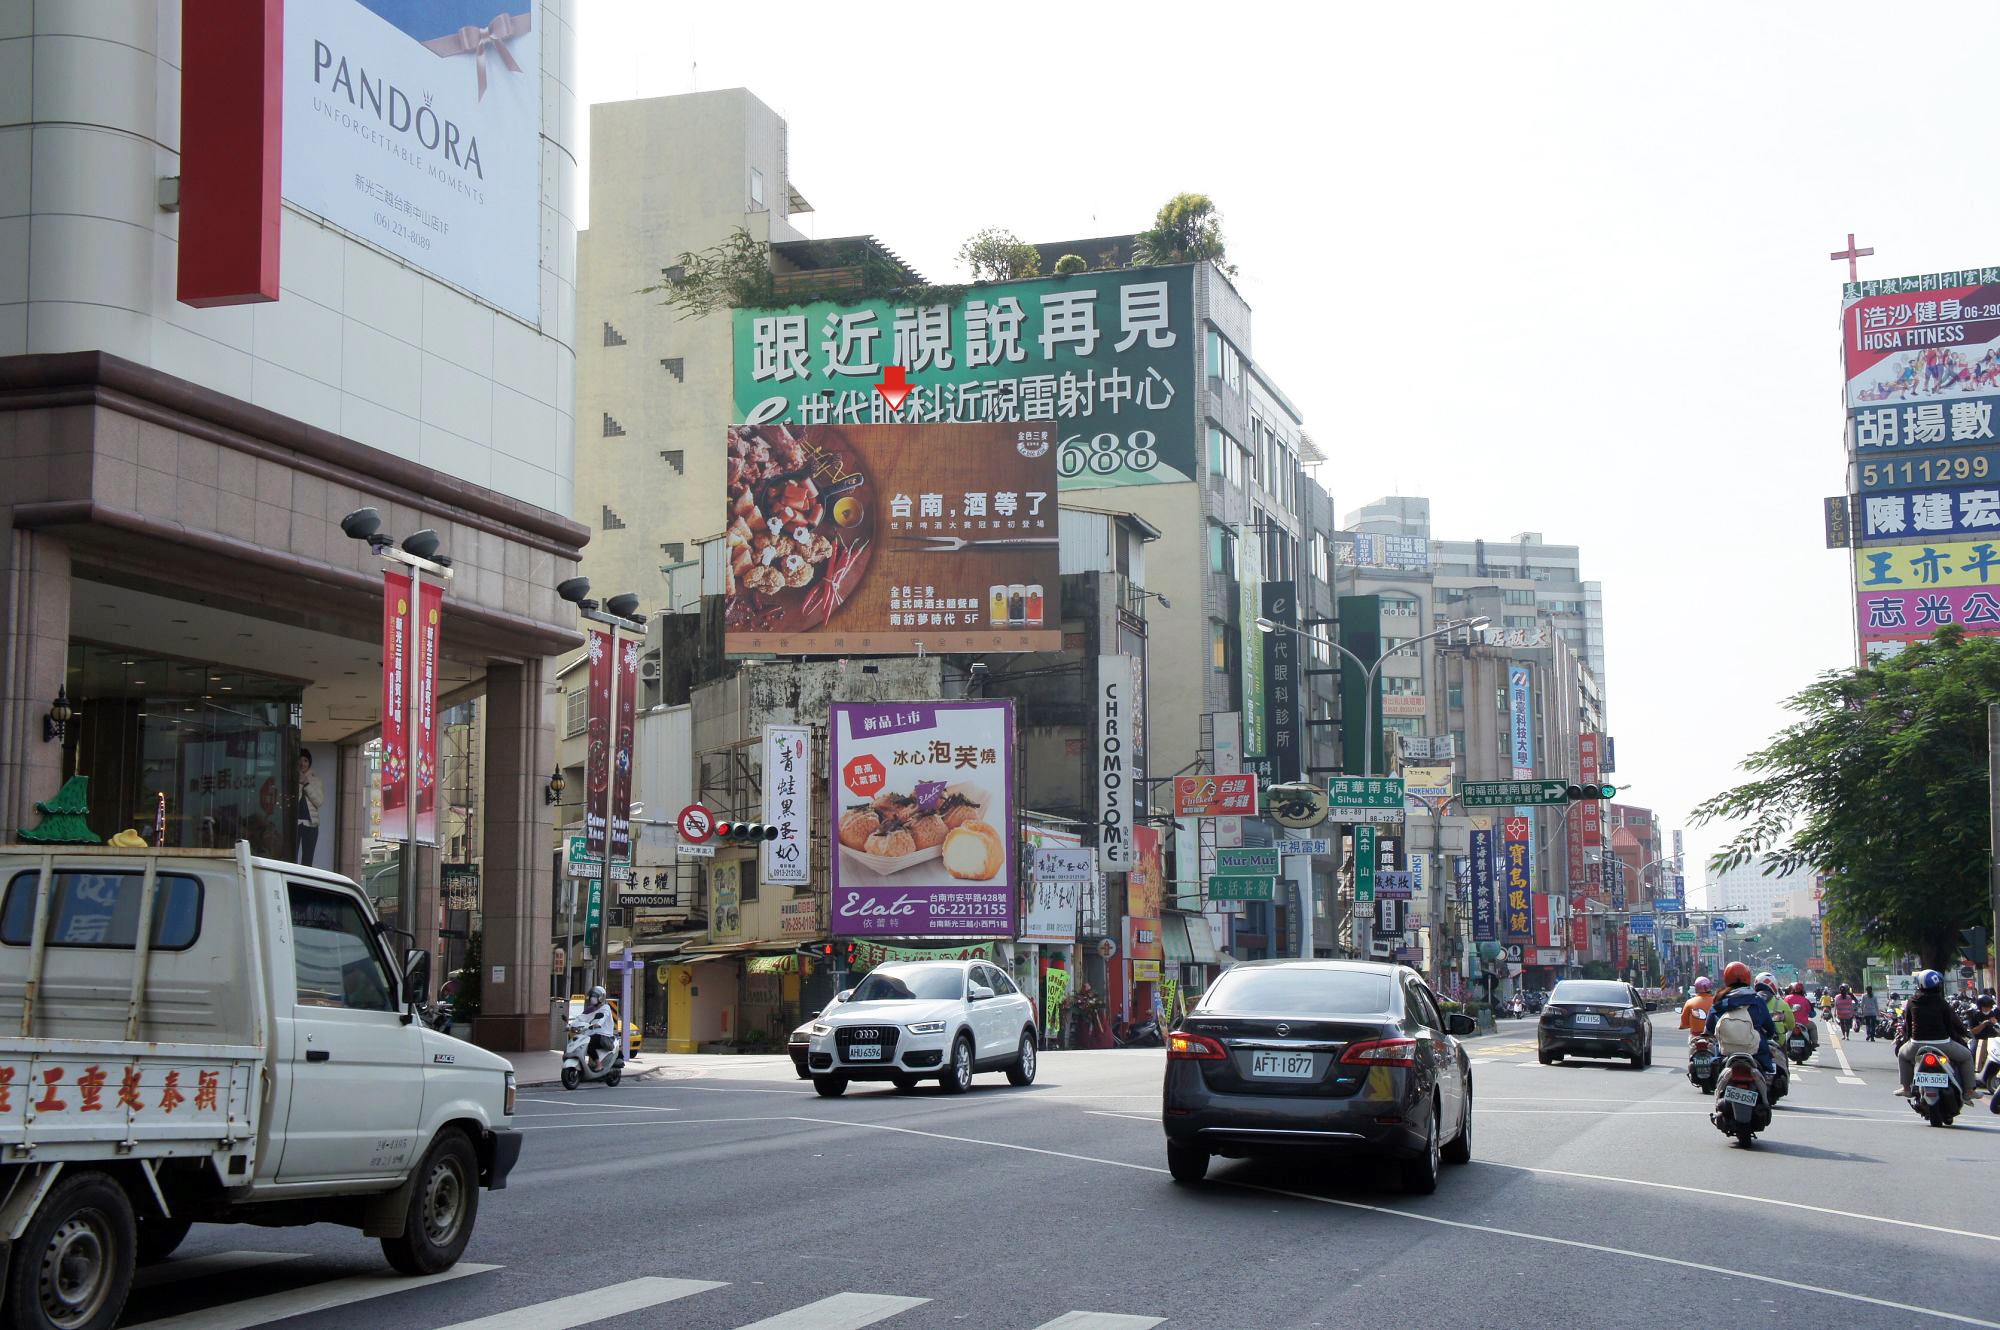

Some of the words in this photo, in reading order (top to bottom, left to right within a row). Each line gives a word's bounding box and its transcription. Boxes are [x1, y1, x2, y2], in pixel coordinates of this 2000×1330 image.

[313, 39, 484, 181] PANDORA
[312, 96, 423, 171] UNFORGETTABLE
[428, 165, 484, 205] MOMENTS
[373, 211, 390, 232] (06)
[392, 220, 431, 251] 221-8089
[1863, 298, 1963, 329] 浩沙健身
[751, 280, 1177, 382] 跟近視說再見
[1863, 332, 1902, 351] HOSA
[1906, 324, 1965, 347] FITNESS
[1855, 400, 1995, 448] 胡揚數
[1863, 455, 1989, 487] 5111299
[890, 519, 1046, 530] 世界啤酒大賽冠軍初登場
[1865, 488, 2000, 536] 陳建宏
[890, 585, 935, 599] 金色三麥
[890, 598, 979, 610] 德式啤酒主題餐廳
[890, 613, 956, 626] 南紡夢時代
[964, 613, 979, 625] 5F
[1867, 592, 2000, 628] 志光公
[863, 711, 921, 731] 新品上市
[893, 740, 997, 770] 冰心泡芙燒
[1102, 683, 1122, 862] CHROMOSOME
[1335, 780, 1398, 794] 西華南街
[1337, 795, 1363, 804] Sihua
[1360, 828, 1370, 838] 西
[1222, 855, 1248, 867] Mur
[1250, 854, 1276, 866] Mur
[1360, 842, 1370, 901] 中山路
[620, 896, 675, 905] CHROMOSOME
[929, 893, 1007, 903] 台南市安平路428號
[1507, 843, 1529, 933] 寶島眼鏡
[839, 891, 929, 917] Elate
[929, 904, 1007, 915] 06-2212155
[863, 918, 900, 929] 依蕾特
